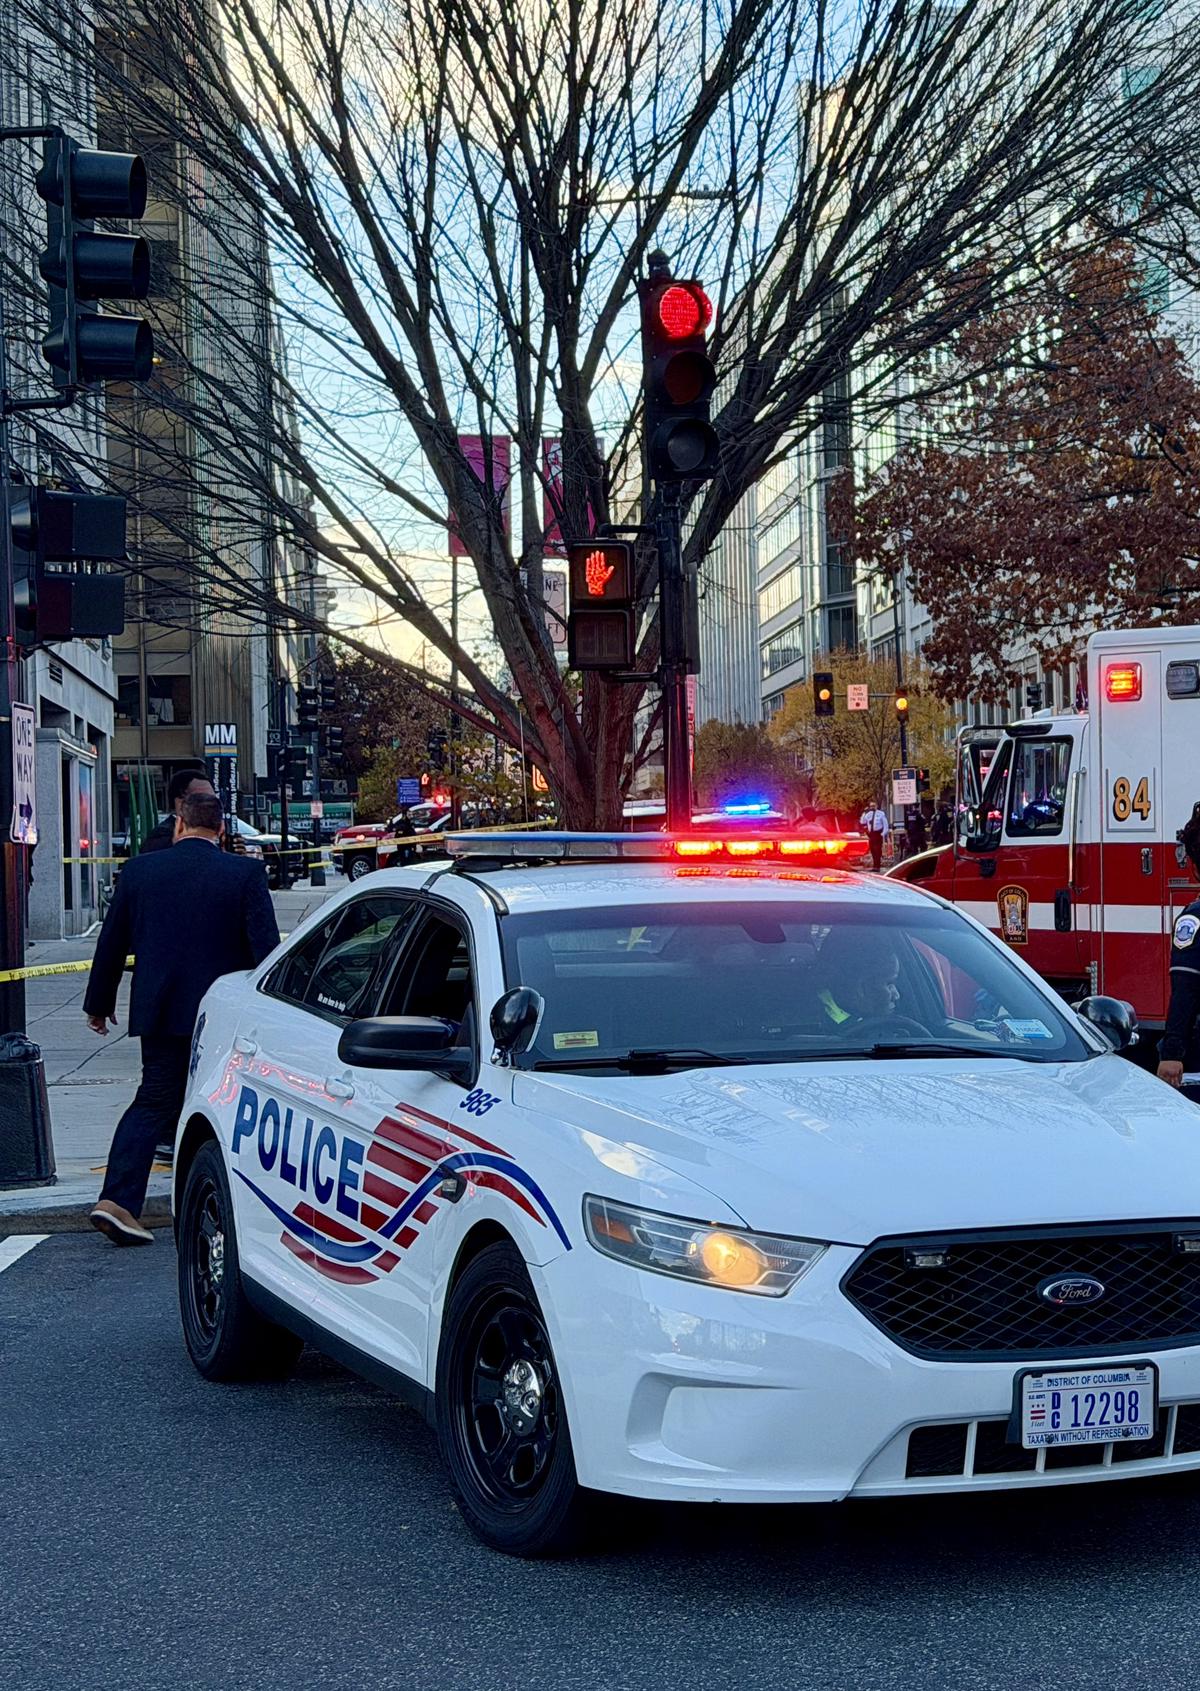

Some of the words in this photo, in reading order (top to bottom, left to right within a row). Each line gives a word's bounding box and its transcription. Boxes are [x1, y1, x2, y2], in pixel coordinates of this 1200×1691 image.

[16, 714, 33, 748] ONE
[16, 753, 33, 783] WAY
[229, 757, 237, 792] Farragut
[1113, 776, 1152, 822] 84
[460, 1088, 502, 1116] 985
[231, 1085, 365, 1222] POLICE
[1059, 1282, 1092, 1299] Ford
[1046, 1376, 1080, 1388] DISTRICT
[1081, 1375, 1092, 1384] OF
[1093, 1373, 1131, 1384] COLUMBIA
[1071, 1390, 1139, 1428] 12298
[1060, 1430, 1091, 1442] WITHOUT
